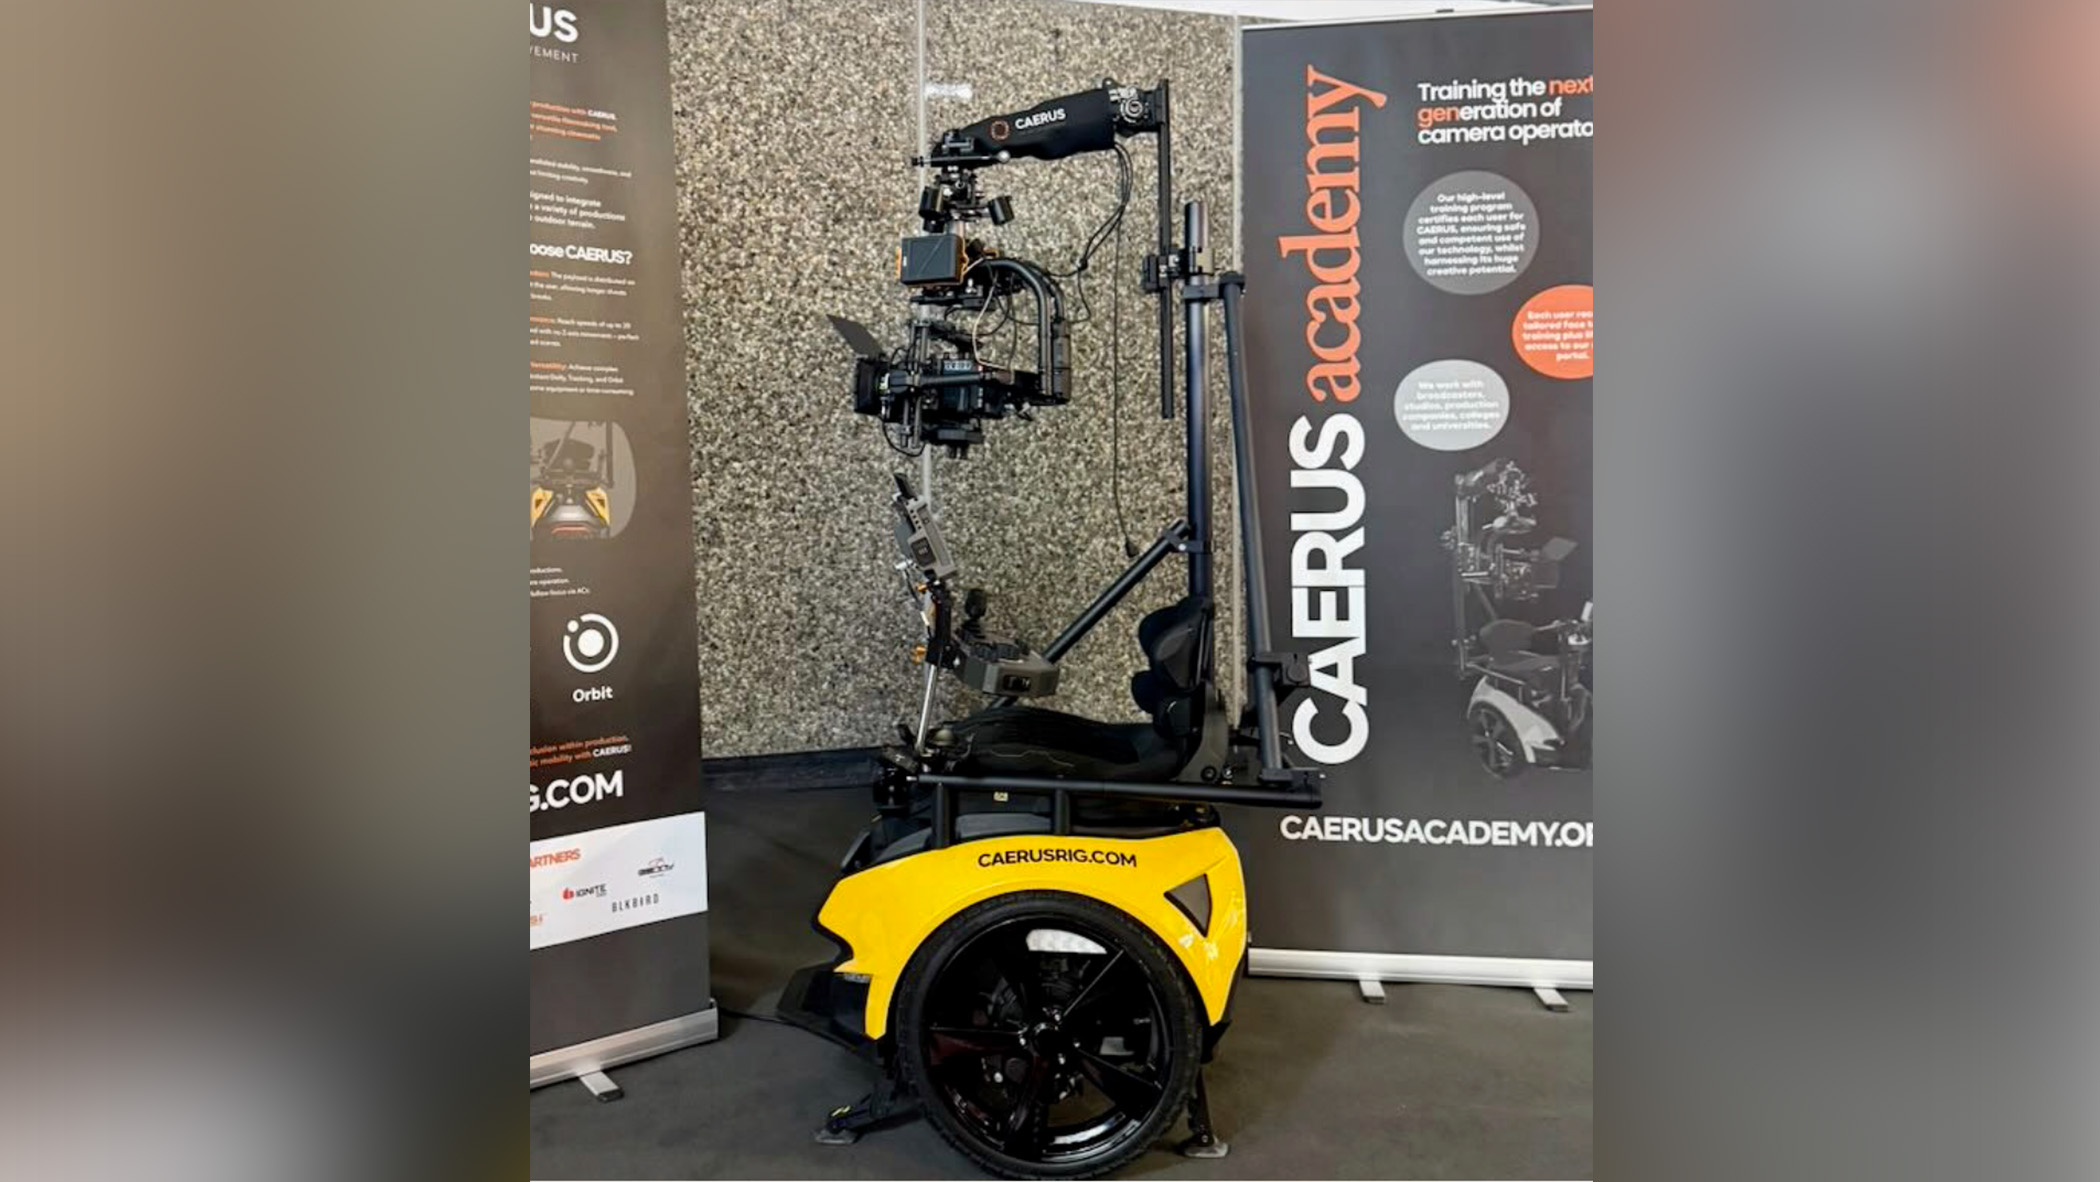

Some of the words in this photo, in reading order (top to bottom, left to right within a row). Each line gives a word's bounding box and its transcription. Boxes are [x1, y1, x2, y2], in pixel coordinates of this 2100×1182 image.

[530, 3, 579, 43] US
[1418, 79, 1506, 102] Training
[1509, 77, 1546, 97] the
[1418, 99, 1537, 128] generation
[1540, 97, 1562, 117] of
[1015, 108, 1067, 130] CAERUS
[1418, 125, 1505, 144] camera
[1508, 119, 1593, 146] operato
[556, 194, 565, 203] to
[566, 194, 602, 208] integrate
[1437, 193, 1455, 203] Our
[1457, 191, 1505, 203] high-level
[541, 204, 568, 217] variety
[569, 206, 578, 216] of
[579, 209, 626, 222] productions
[1430, 204, 1468, 214] training
[1470, 203, 1512, 214] program
[1418, 214, 1459, 224] certifies
[1461, 213, 1485, 222] each
[1486, 213, 1507, 222] user
[1509, 211, 1524, 221] for
[1278, 64, 1387, 402] academy
[1460, 223, 1502, 234] ensuring
[1504, 222, 1526, 232] safe
[1418, 236, 1438, 245] and
[1439, 234, 1493, 245] competent
[1494, 234, 1512, 242] use
[1513, 231, 1525, 241] of
[530, 243, 564, 258] oose
[565, 244, 633, 265] CAERUS?
[1418, 247, 1435, 256] our
[1495, 244, 1524, 253] whilst
[1424, 256, 1478, 266] harnessing
[1480, 255, 1492, 263] its
[1494, 254, 1519, 264] huge
[1427, 266, 1467, 276] creative
[1469, 264, 1517, 276] potential.
[1527, 310, 1552, 320] Each
[1553, 311, 1575, 320] user
[1522, 321, 1561, 331] tailored
[1563, 320, 1586, 329] face
[1522, 331, 1561, 341] training
[1562, 331, 1583, 341] plus
[1524, 343, 1559, 351] access
[1560, 342, 1571, 350] to
[1573, 342, 1589, 350] our
[1418, 381, 1434, 390] We
[1435, 380, 1460, 389] work
[1462, 380, 1484, 389] with
[1444, 401, 1499, 411] production
[1459, 411, 1500, 421] colleges
[1411, 422, 1431, 431] and
[1289, 413, 1369, 764] CAERUS
[572, 686, 614, 703] Orbit
[978, 849, 1137, 868] CAERUSRIG.COM
